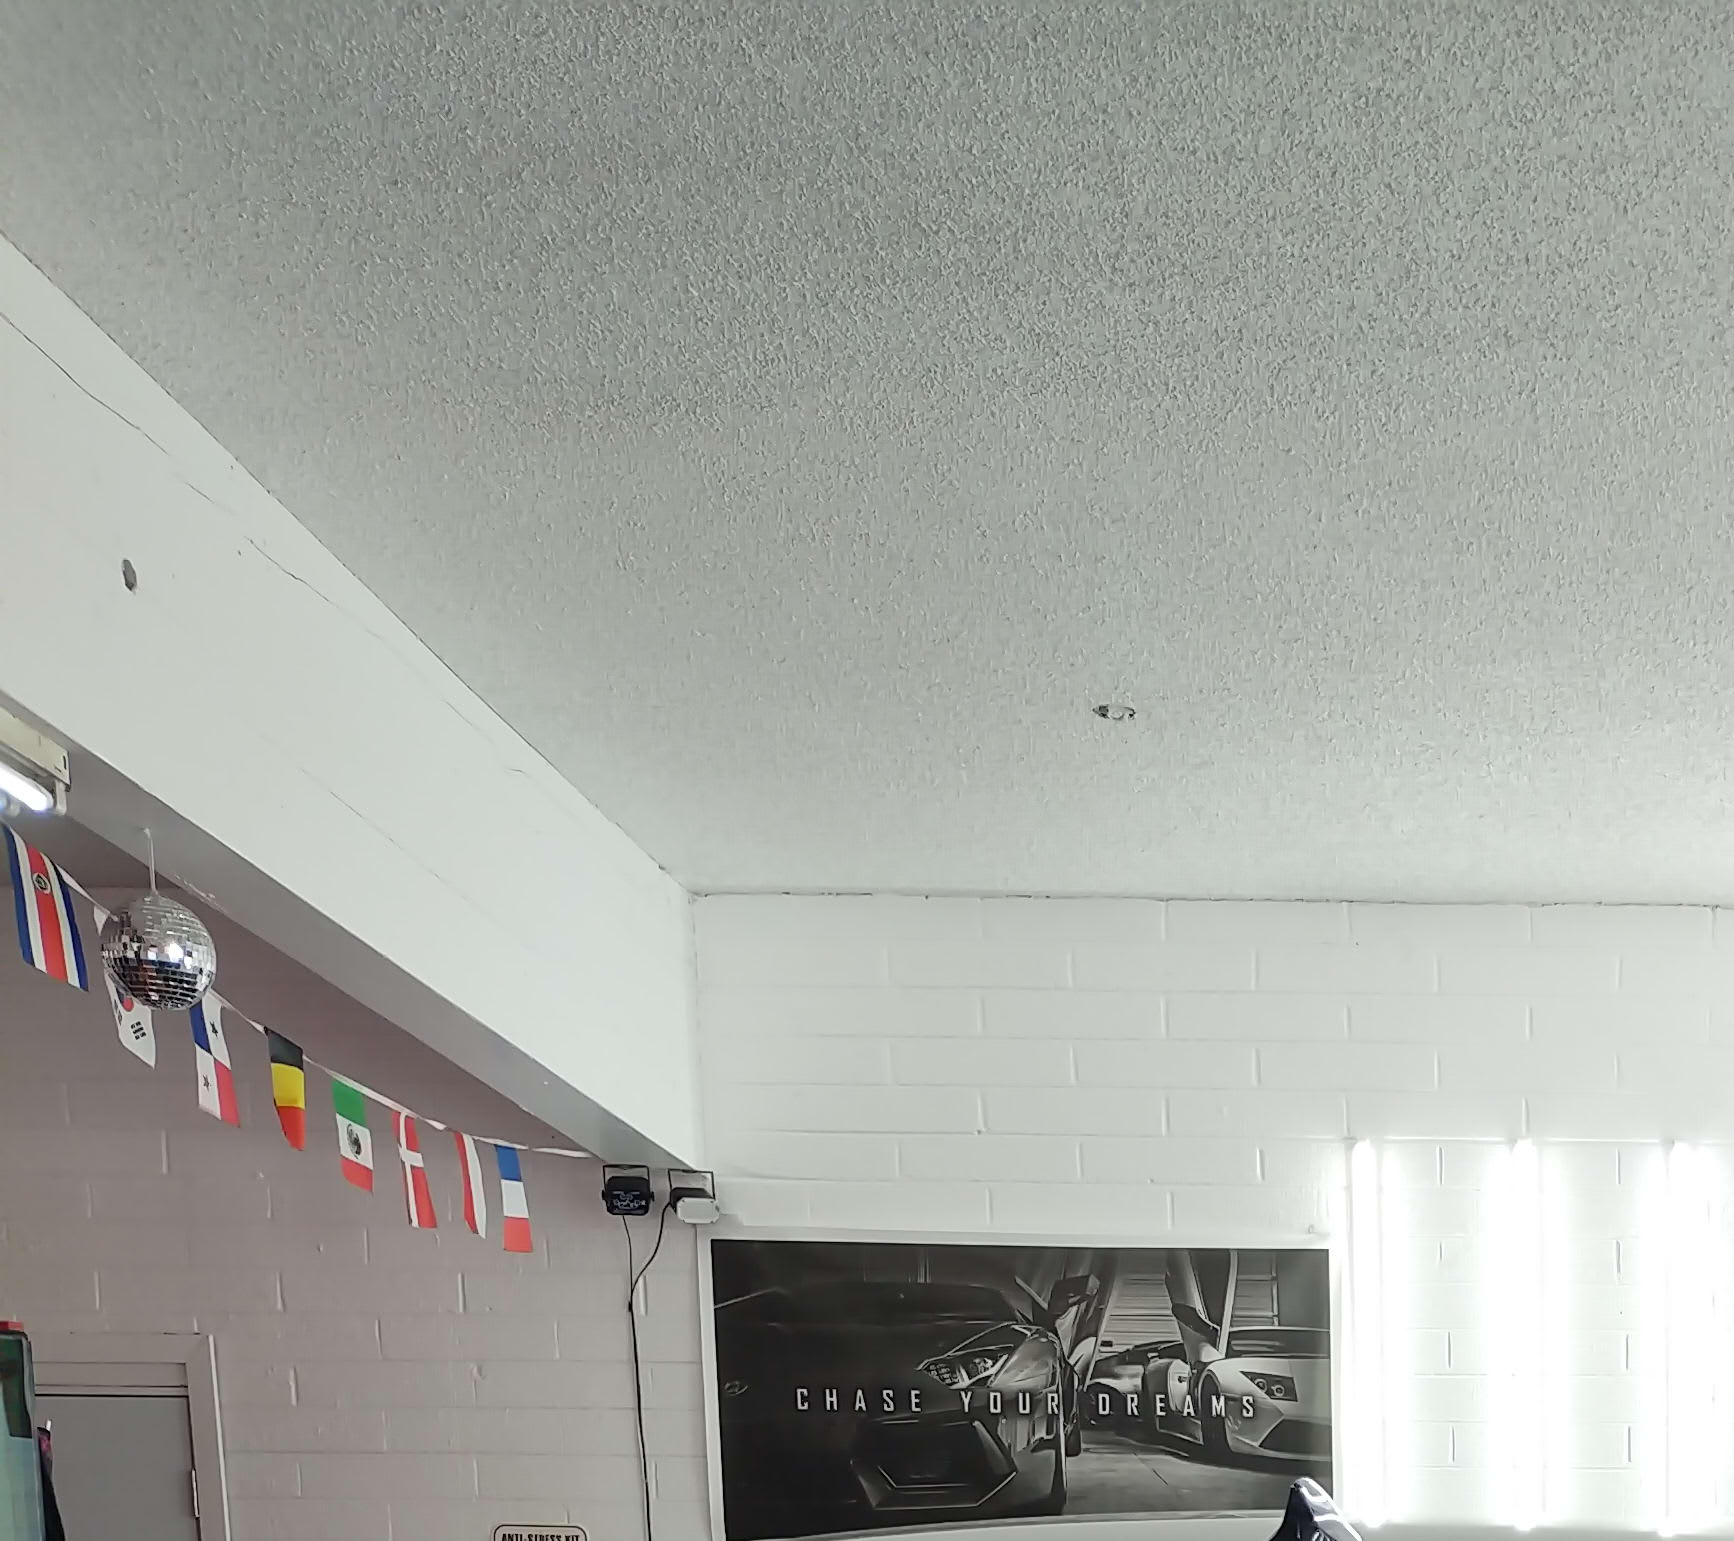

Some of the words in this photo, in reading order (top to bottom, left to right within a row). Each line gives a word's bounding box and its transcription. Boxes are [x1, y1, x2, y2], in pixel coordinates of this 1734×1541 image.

[797, 1388, 922, 1412] CHASE
[960, 1391, 1059, 1415] YOUR
[1098, 1393, 1254, 1418] DREAMS
